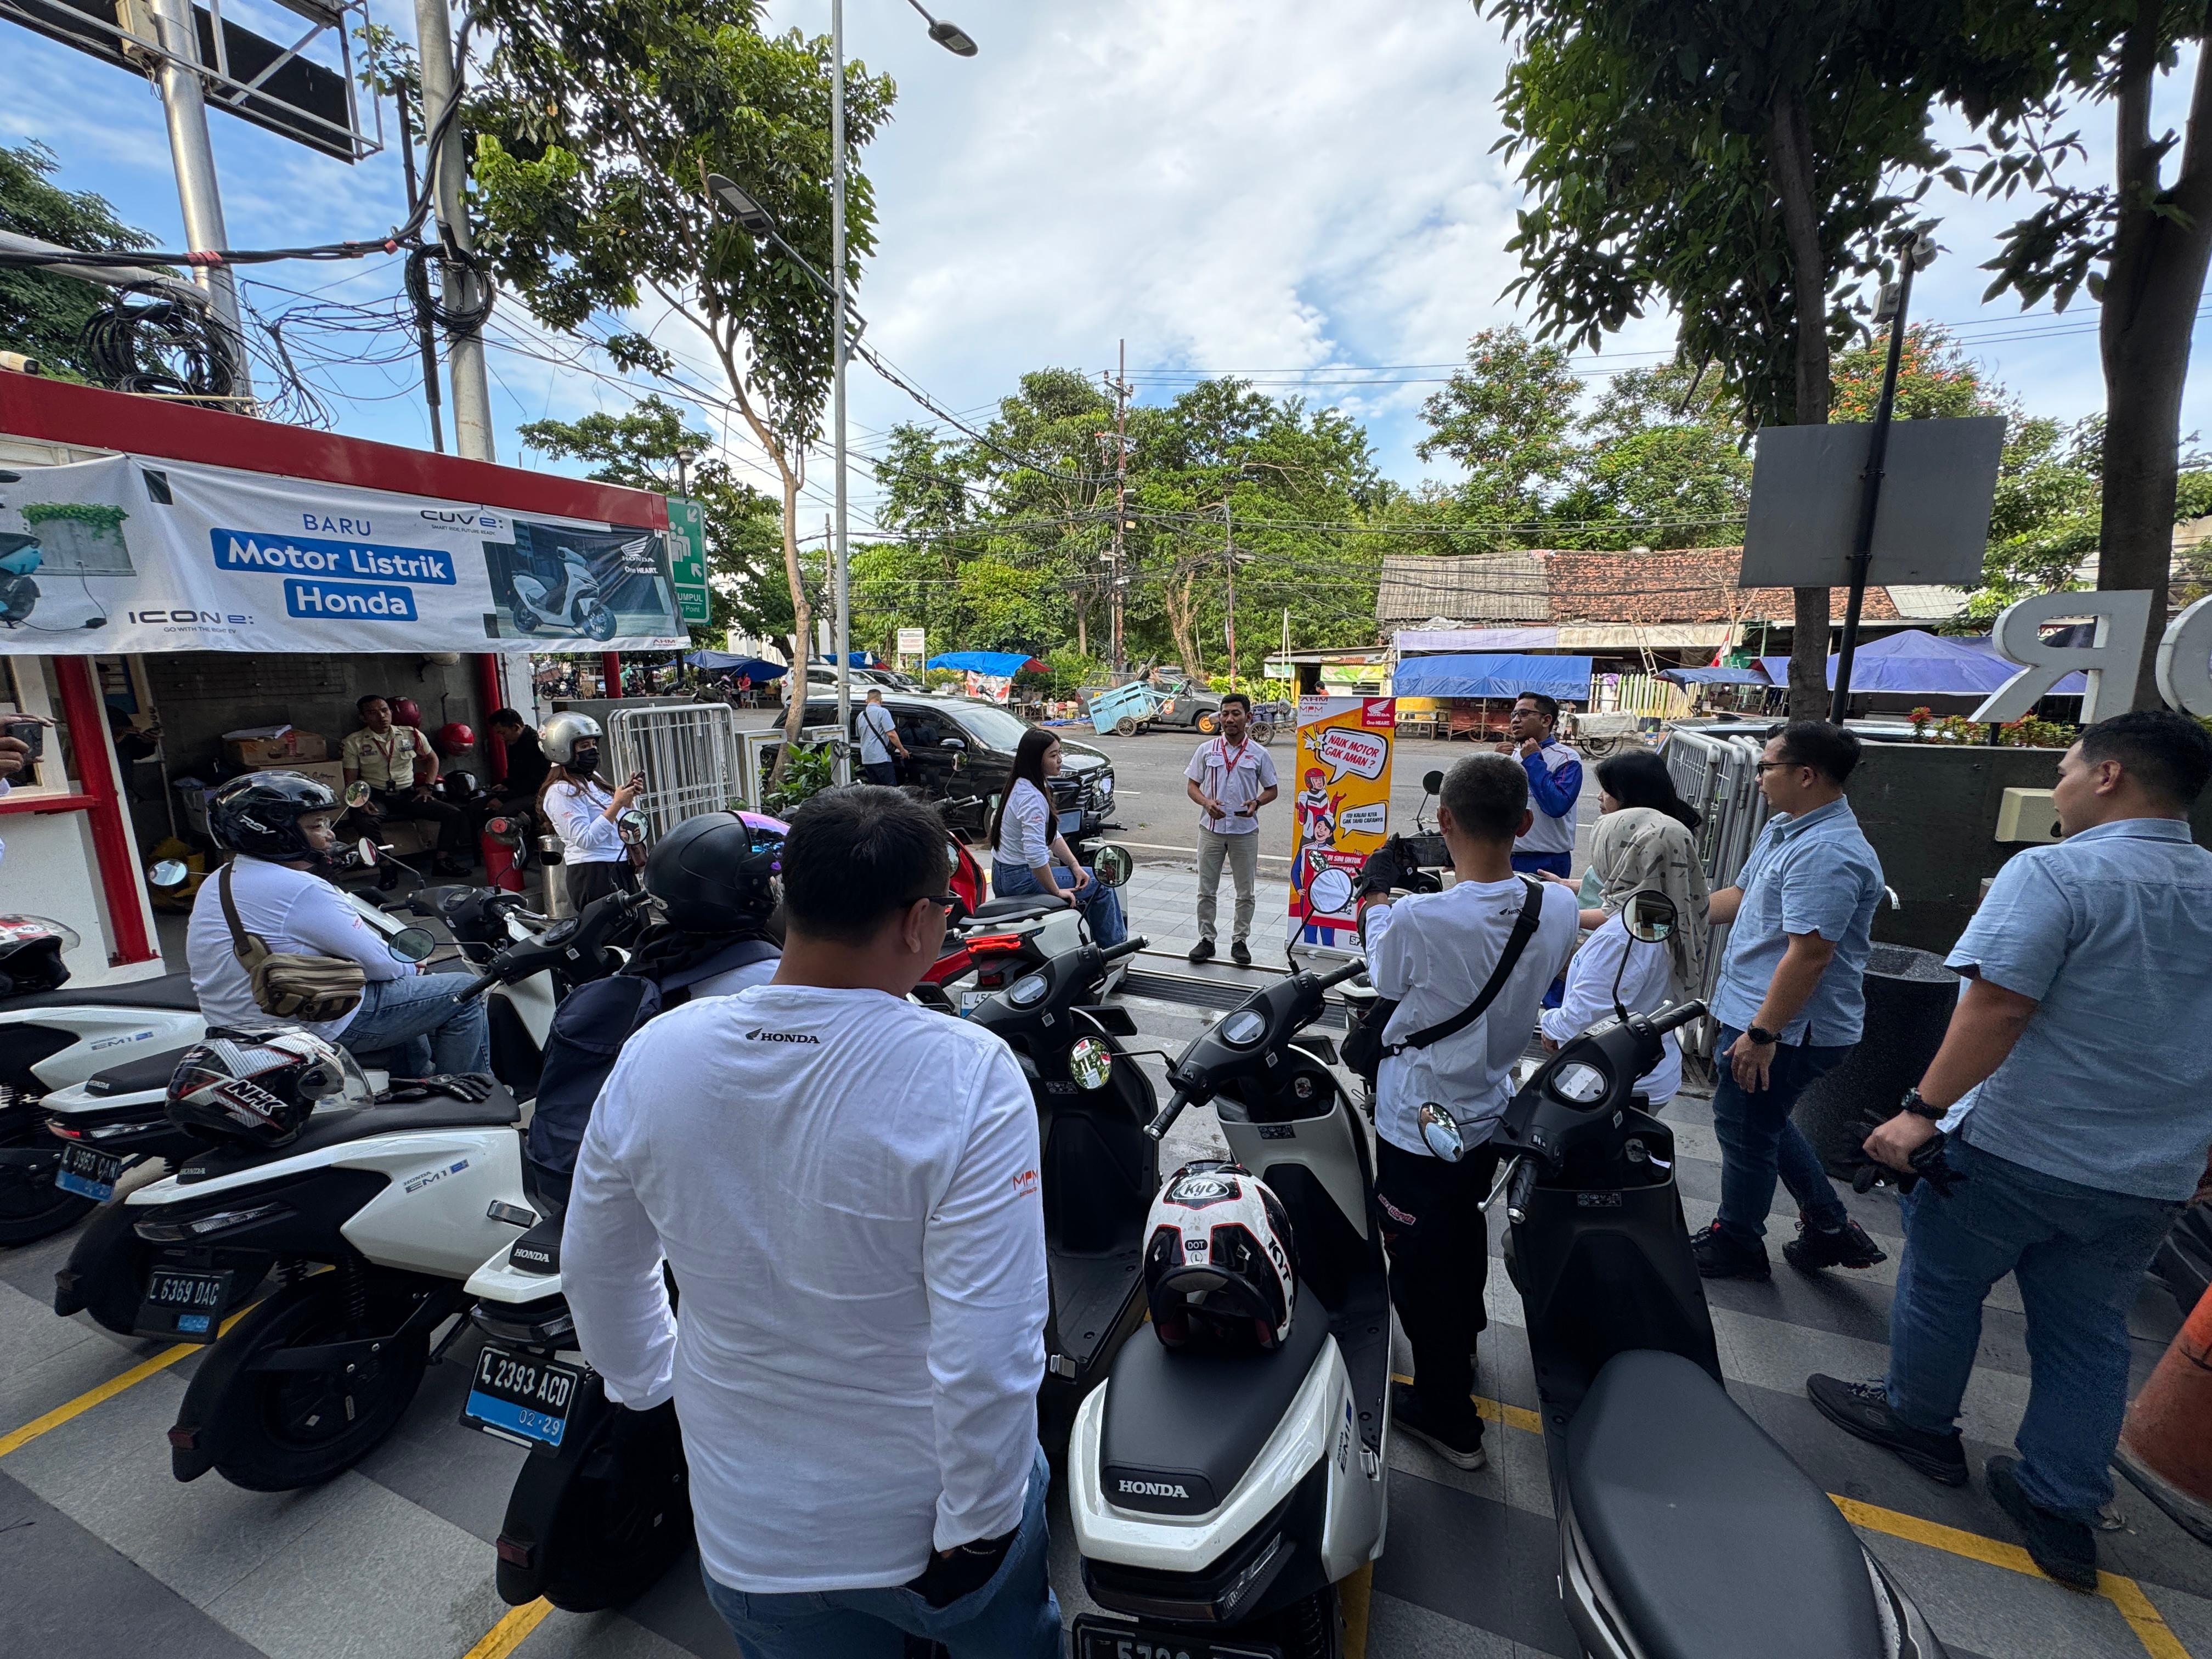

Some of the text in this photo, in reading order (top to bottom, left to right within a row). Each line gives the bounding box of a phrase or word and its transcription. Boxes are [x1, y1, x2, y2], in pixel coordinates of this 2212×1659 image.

[303, 514, 371, 536] BARU
[420, 510, 474, 524] CUV
[229, 537, 447, 579] Motor Listrik
[296, 586, 408, 616] Honda
[678, 592, 703, 602] UMPUL
[128, 610, 221, 624] ICON
[1328, 735, 1380, 757] NAIK MOTOR
[1325, 747, 1344, 759] GAK
[1343, 754, 1369, 767] AMAN
[964, 994, 969, 1005] L
[760, 1032, 821, 1044] HONDA
[224, 1079, 289, 1116] NHK
[403, 1171, 432, 1186] HONDA
[405, 1169, 448, 1194] EM1
[1013, 1167, 1039, 1190] MPM
[1188, 1241, 1204, 1249] DOT
[514, 1249, 550, 1262] HONDA
[149, 1278, 158, 1299] L
[161, 1278, 193, 1303] 6369
[482, 1353, 569, 1407] L 2393 ACD
[1119, 1480, 1189, 1498] HONDA
